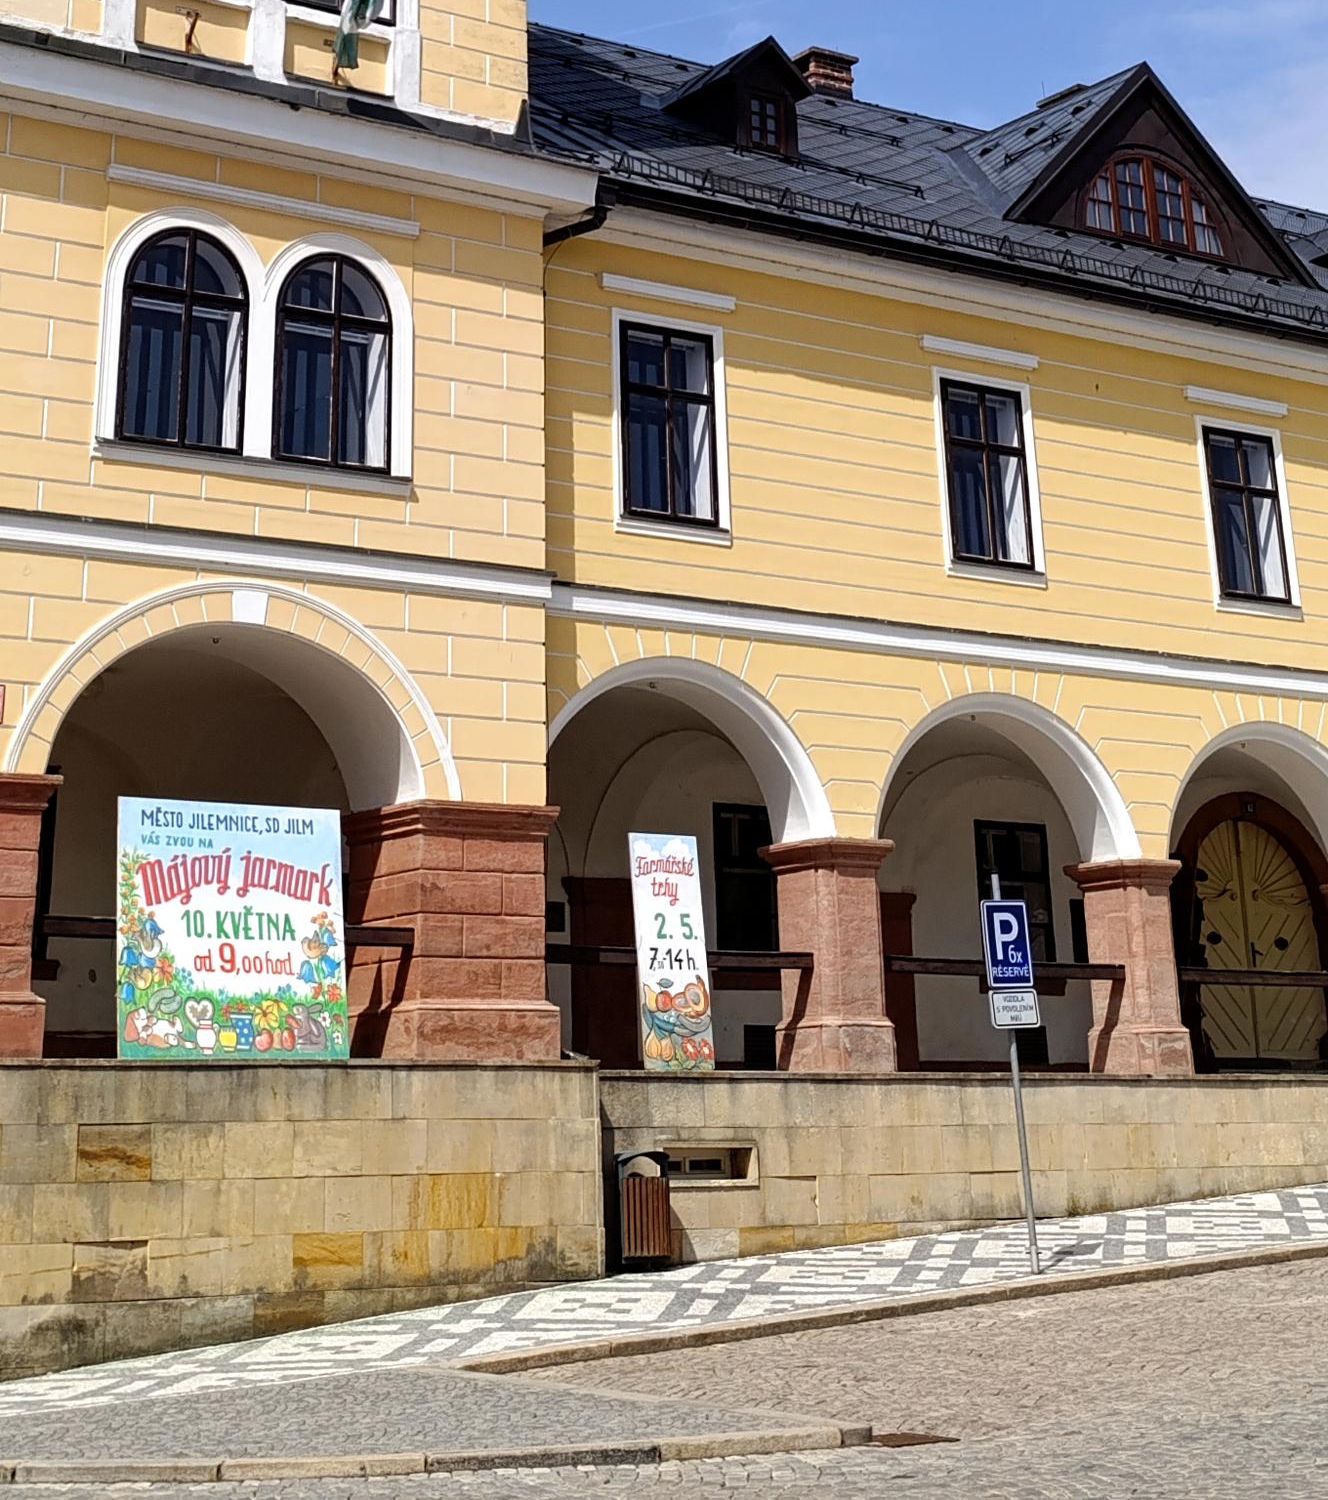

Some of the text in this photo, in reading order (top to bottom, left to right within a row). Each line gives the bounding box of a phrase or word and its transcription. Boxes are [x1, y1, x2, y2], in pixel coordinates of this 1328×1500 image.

[141, 807, 183, 829] MĚSTO
[265, 817, 280, 834] SD
[284, 817, 314, 835] JILM
[141, 831, 214, 849] VÁS ZVOU NA
[136, 847, 333, 907] Májový jarmark
[634, 854, 694, 878] Farmářské
[651, 876, 680, 906] trhy
[180, 905, 297, 941] 10. KVĚTNA
[654, 912, 698, 940] 2. 5.
[993, 912, 1019, 960] P
[194, 949, 215, 973] od
[1008, 944, 1023, 963] 6x
